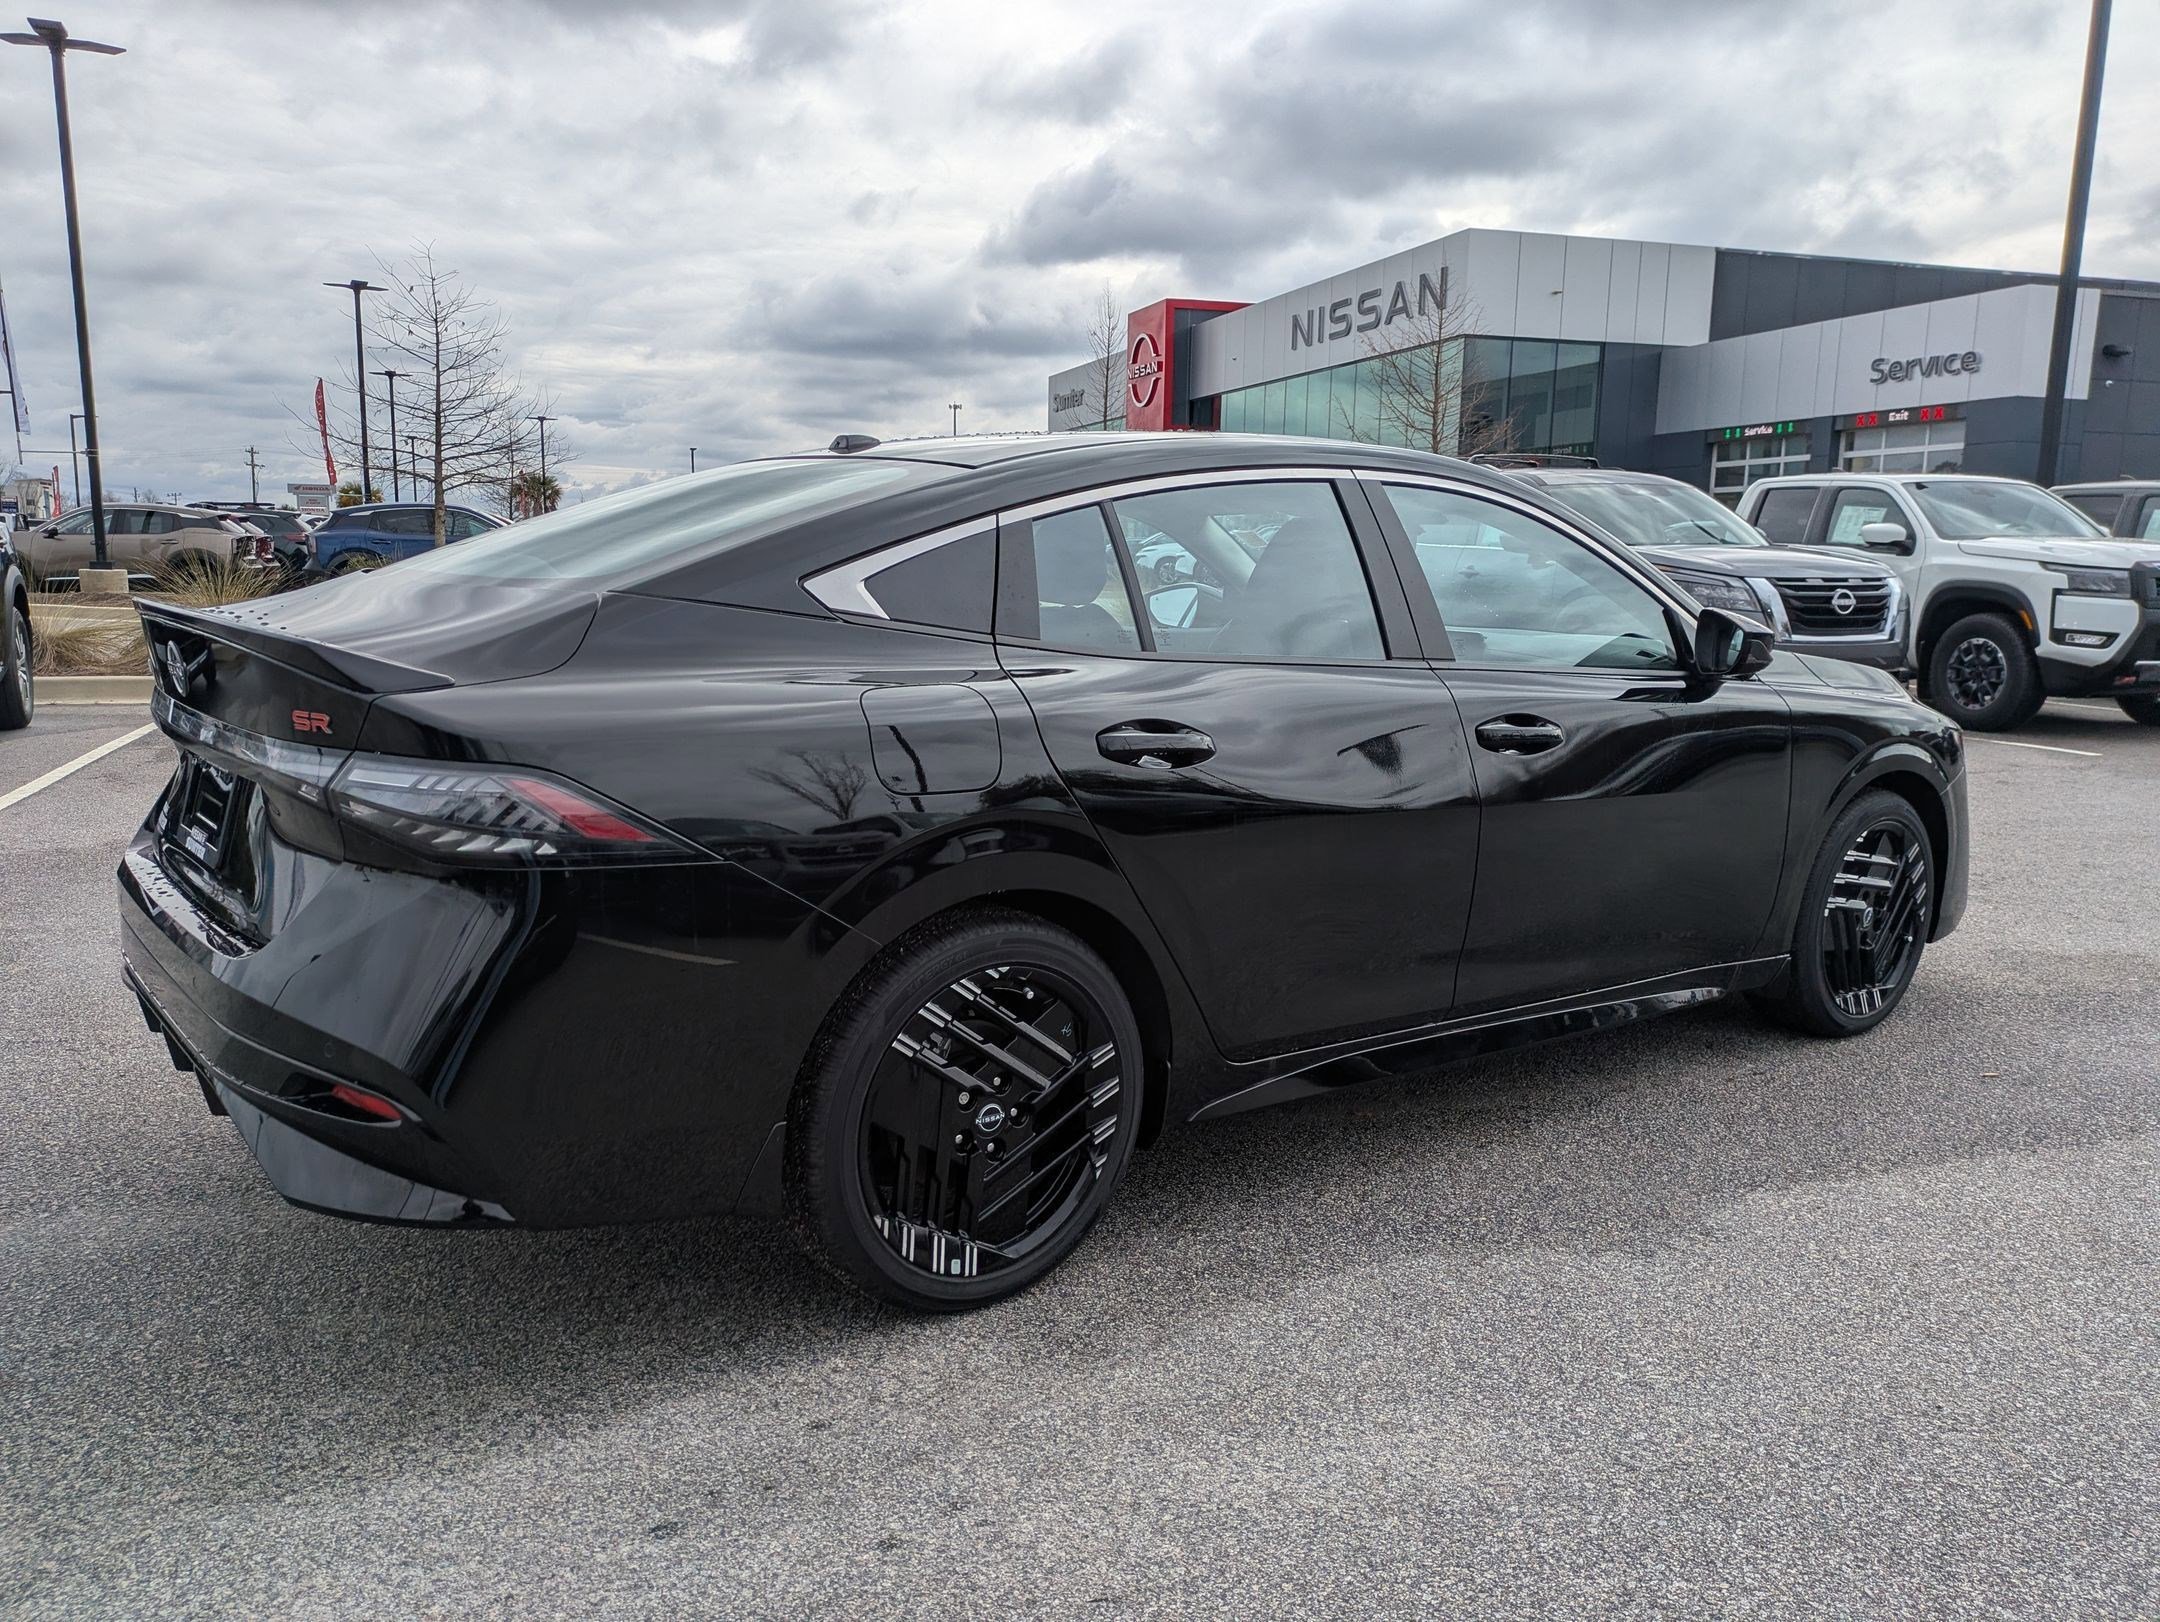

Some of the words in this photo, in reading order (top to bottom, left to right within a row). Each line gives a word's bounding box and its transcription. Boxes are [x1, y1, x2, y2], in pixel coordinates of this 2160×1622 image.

[1291, 266, 1449, 351] NISSAN
[1127, 361, 1158, 379] NISSAN
[1869, 351, 1981, 385] Service
[1888, 410, 1909, 422] Exit
[1743, 425, 1773, 436] Service
[292, 710, 333, 734] SR
[975, 1112, 1005, 1125] NISSAN
